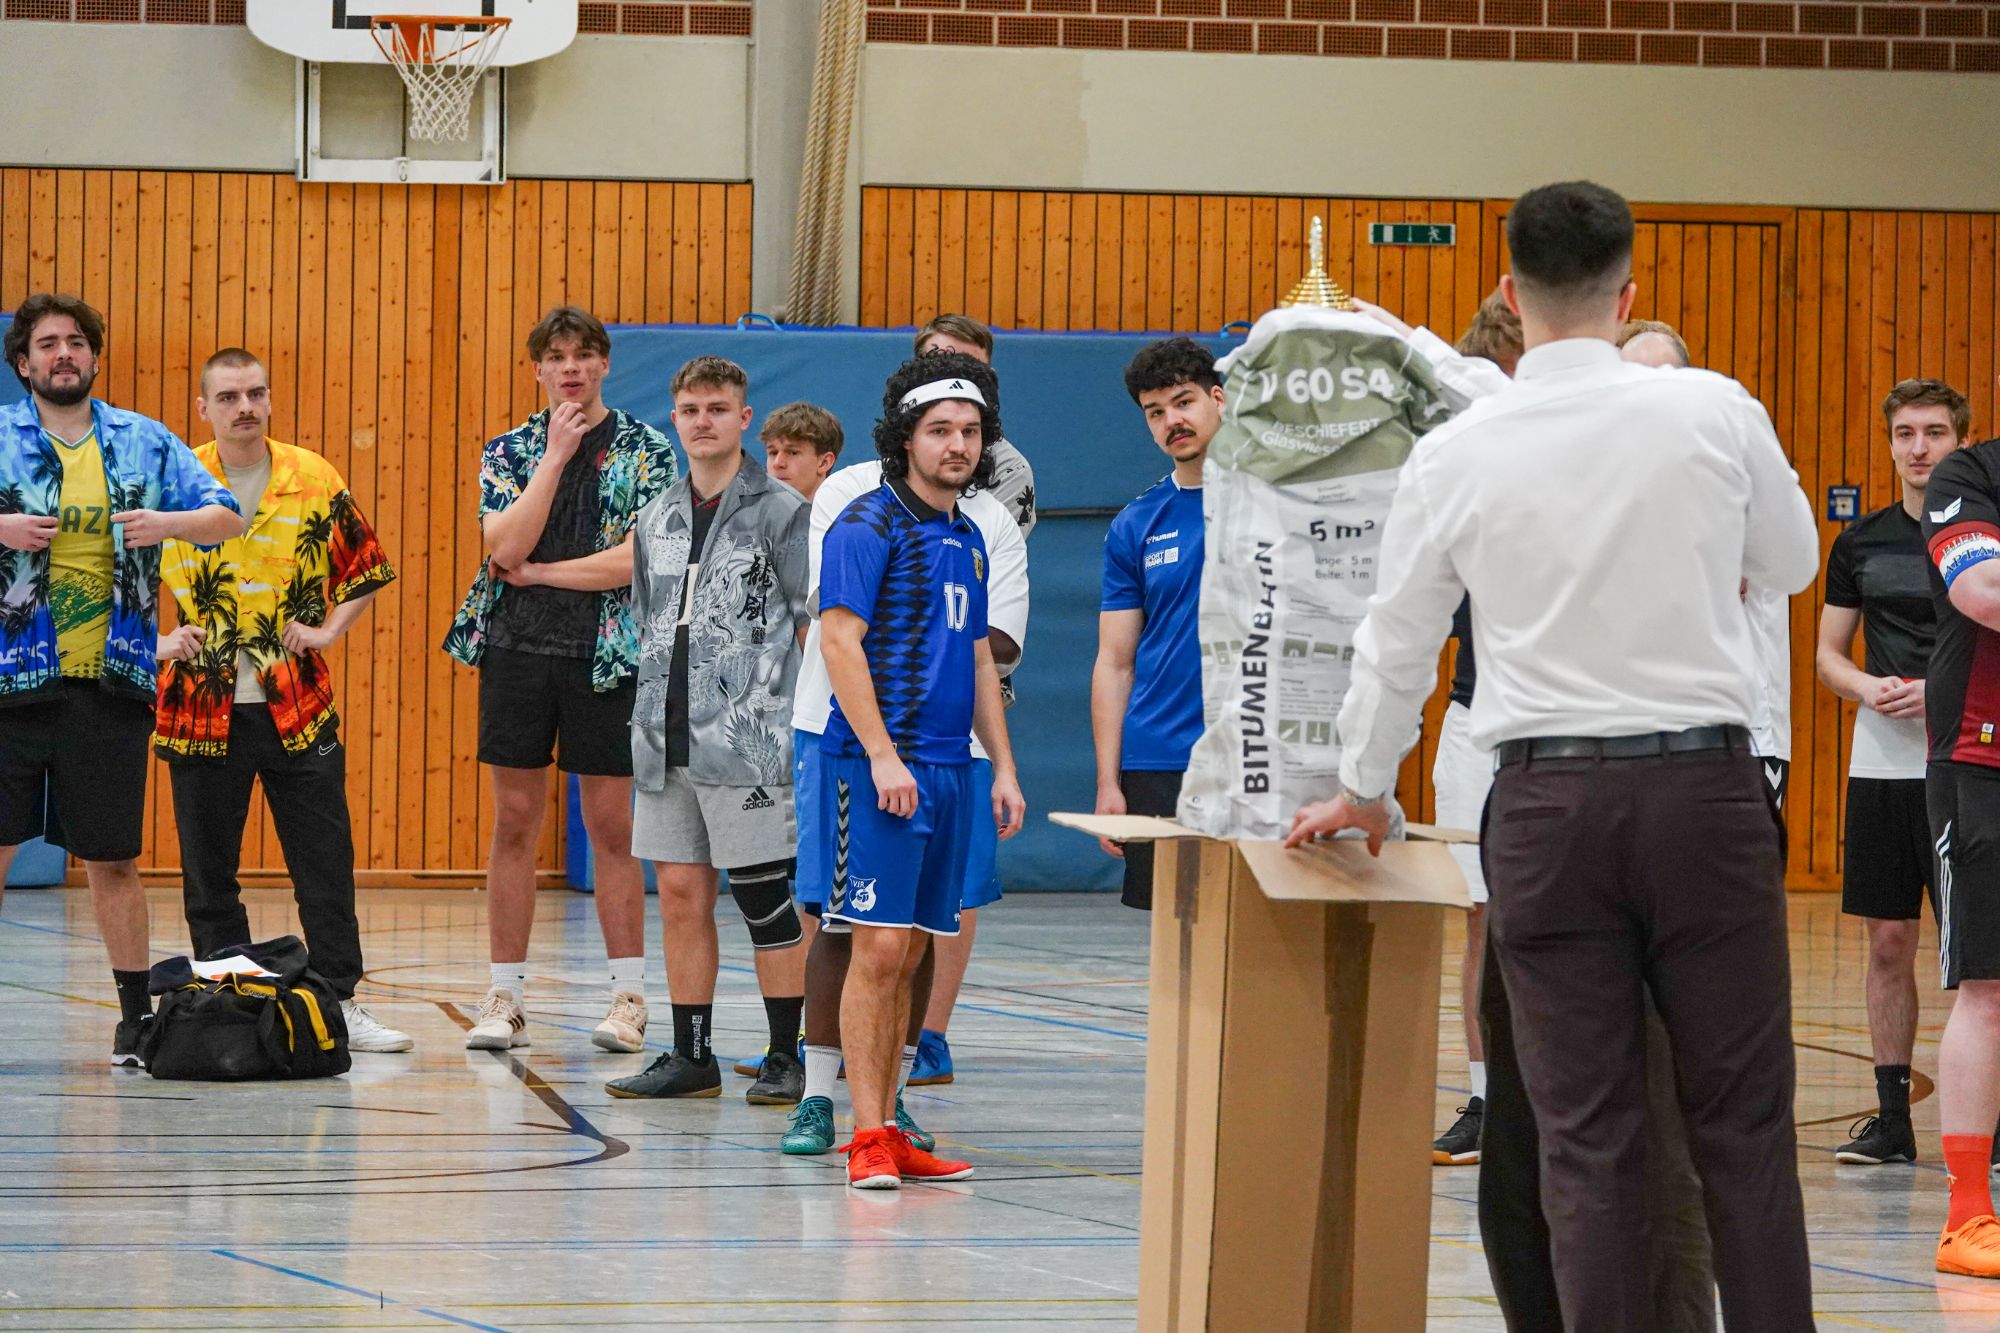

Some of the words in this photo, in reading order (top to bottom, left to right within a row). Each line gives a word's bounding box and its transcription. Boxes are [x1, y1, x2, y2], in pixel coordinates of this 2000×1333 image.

[1286, 366, 1335, 404] 60
[1340, 366, 1395, 399] S4
[1310, 519, 1328, 542] 5
[1335, 519, 1375, 540] m²
[942, 537, 963, 549] adidas
[943, 582, 970, 633] 10
[741, 799, 775, 811] adidas
